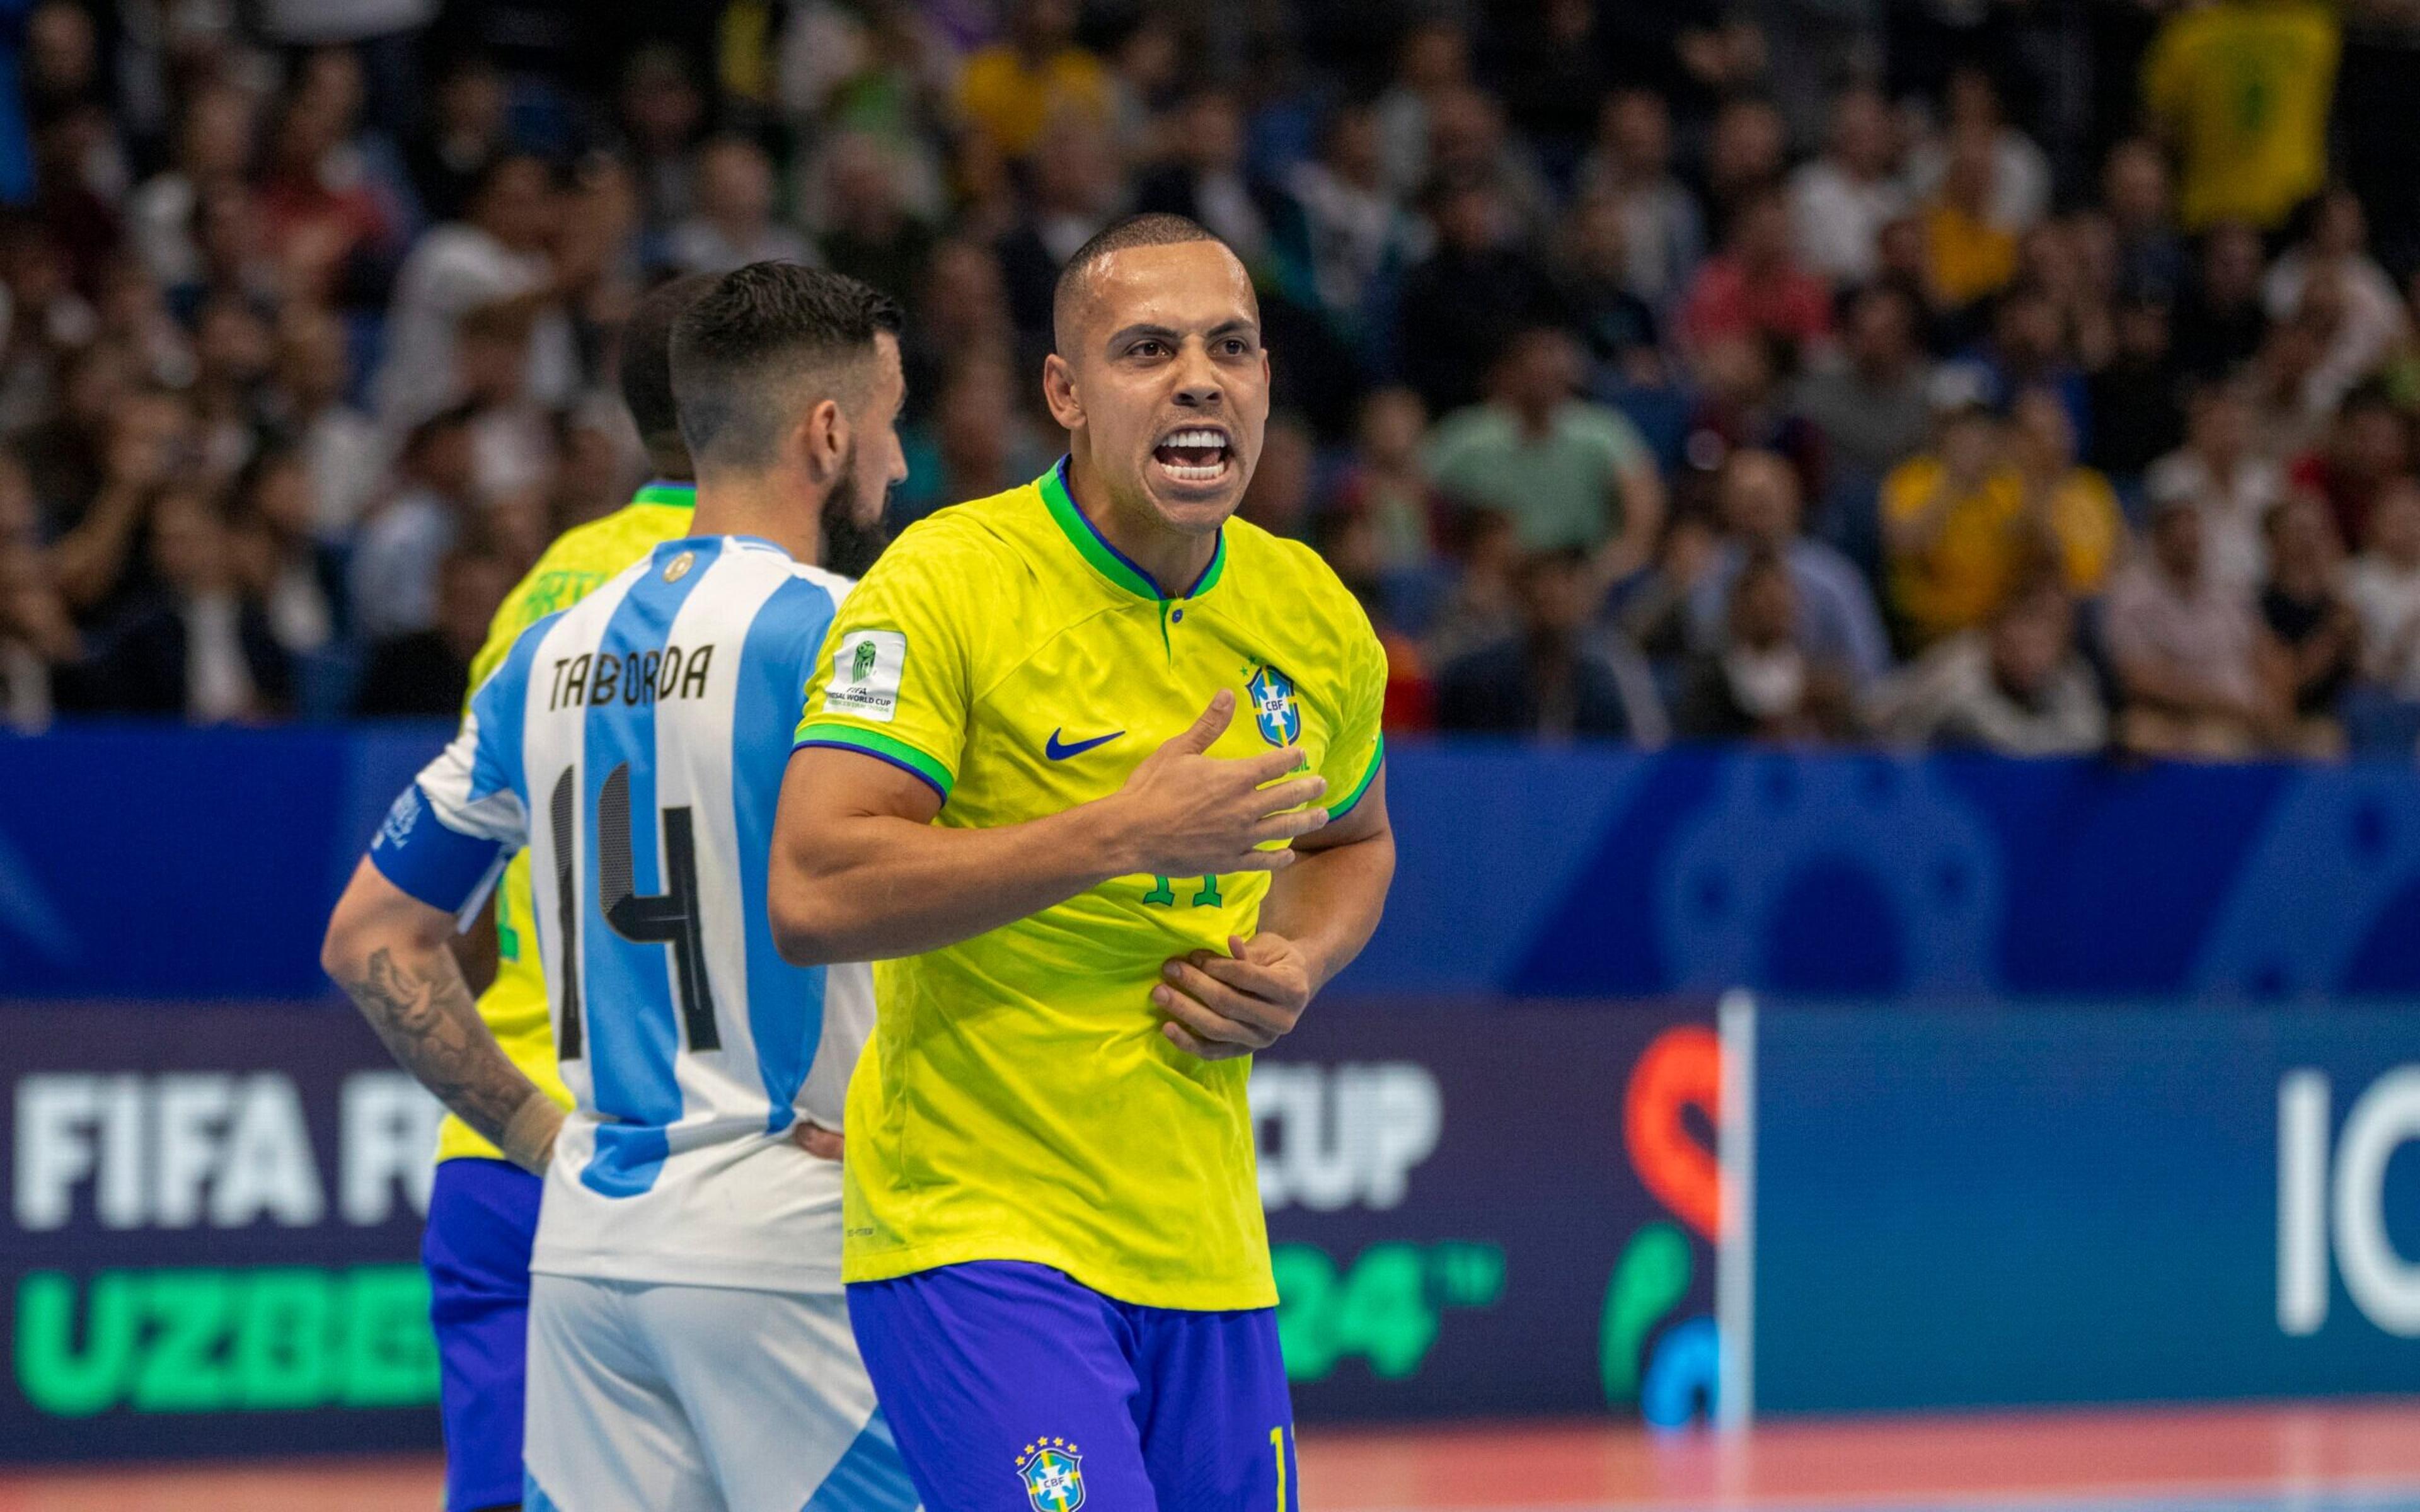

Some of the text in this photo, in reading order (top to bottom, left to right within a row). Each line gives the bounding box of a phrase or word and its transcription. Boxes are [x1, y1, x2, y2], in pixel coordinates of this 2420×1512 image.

[550, 644, 715, 712] TABORDA
[847, 694, 875, 704] WORLD
[875, 698, 892, 706] CUP
[1265, 699, 1284, 711] CBF
[550, 761, 722, 1060] 14
[14, 1071, 325, 1229] FIFA
[1044, 1477, 1064, 1488] CBF
